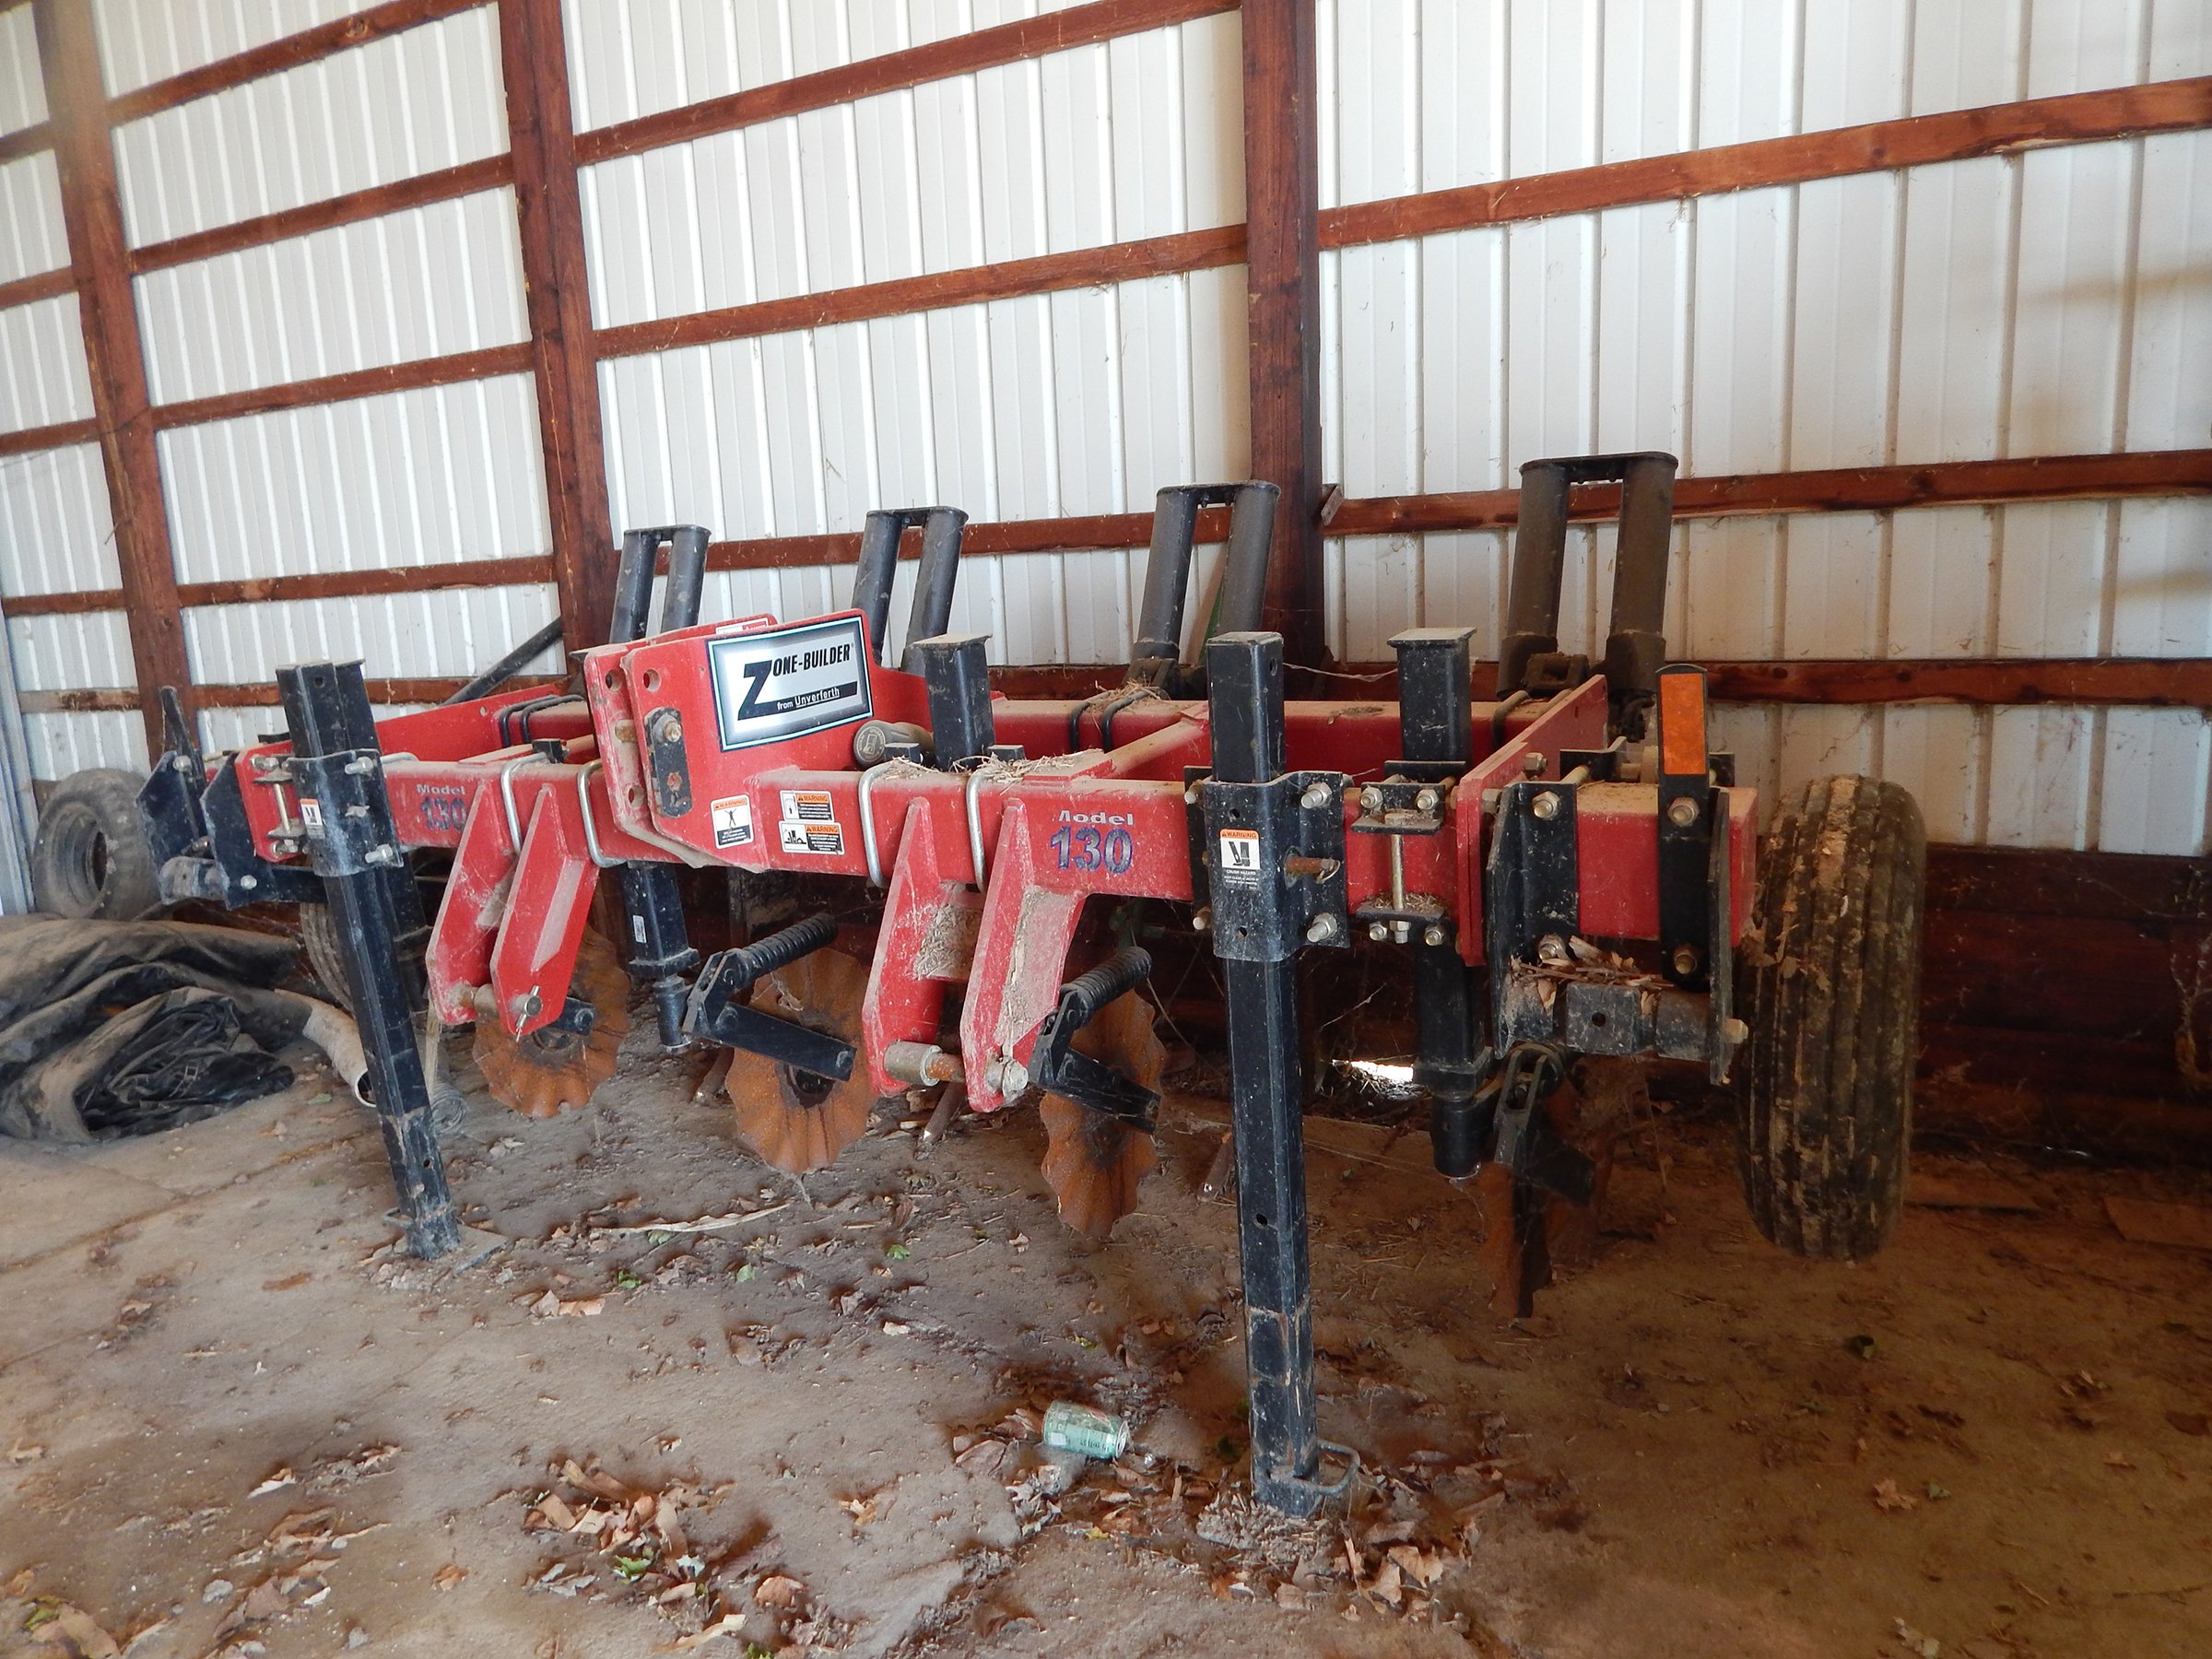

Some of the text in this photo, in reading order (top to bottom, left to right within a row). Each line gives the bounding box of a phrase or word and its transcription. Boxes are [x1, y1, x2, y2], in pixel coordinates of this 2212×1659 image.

[737, 643, 852, 721] ZONE-BUILDER
[777, 687, 841, 711] from Unverferth
[416, 783, 466, 795] Model
[420, 795, 467, 832] 130
[719, 798, 746, 808] WARNING
[812, 825, 838, 833] WARNING
[1050, 826, 1134, 875] 130
